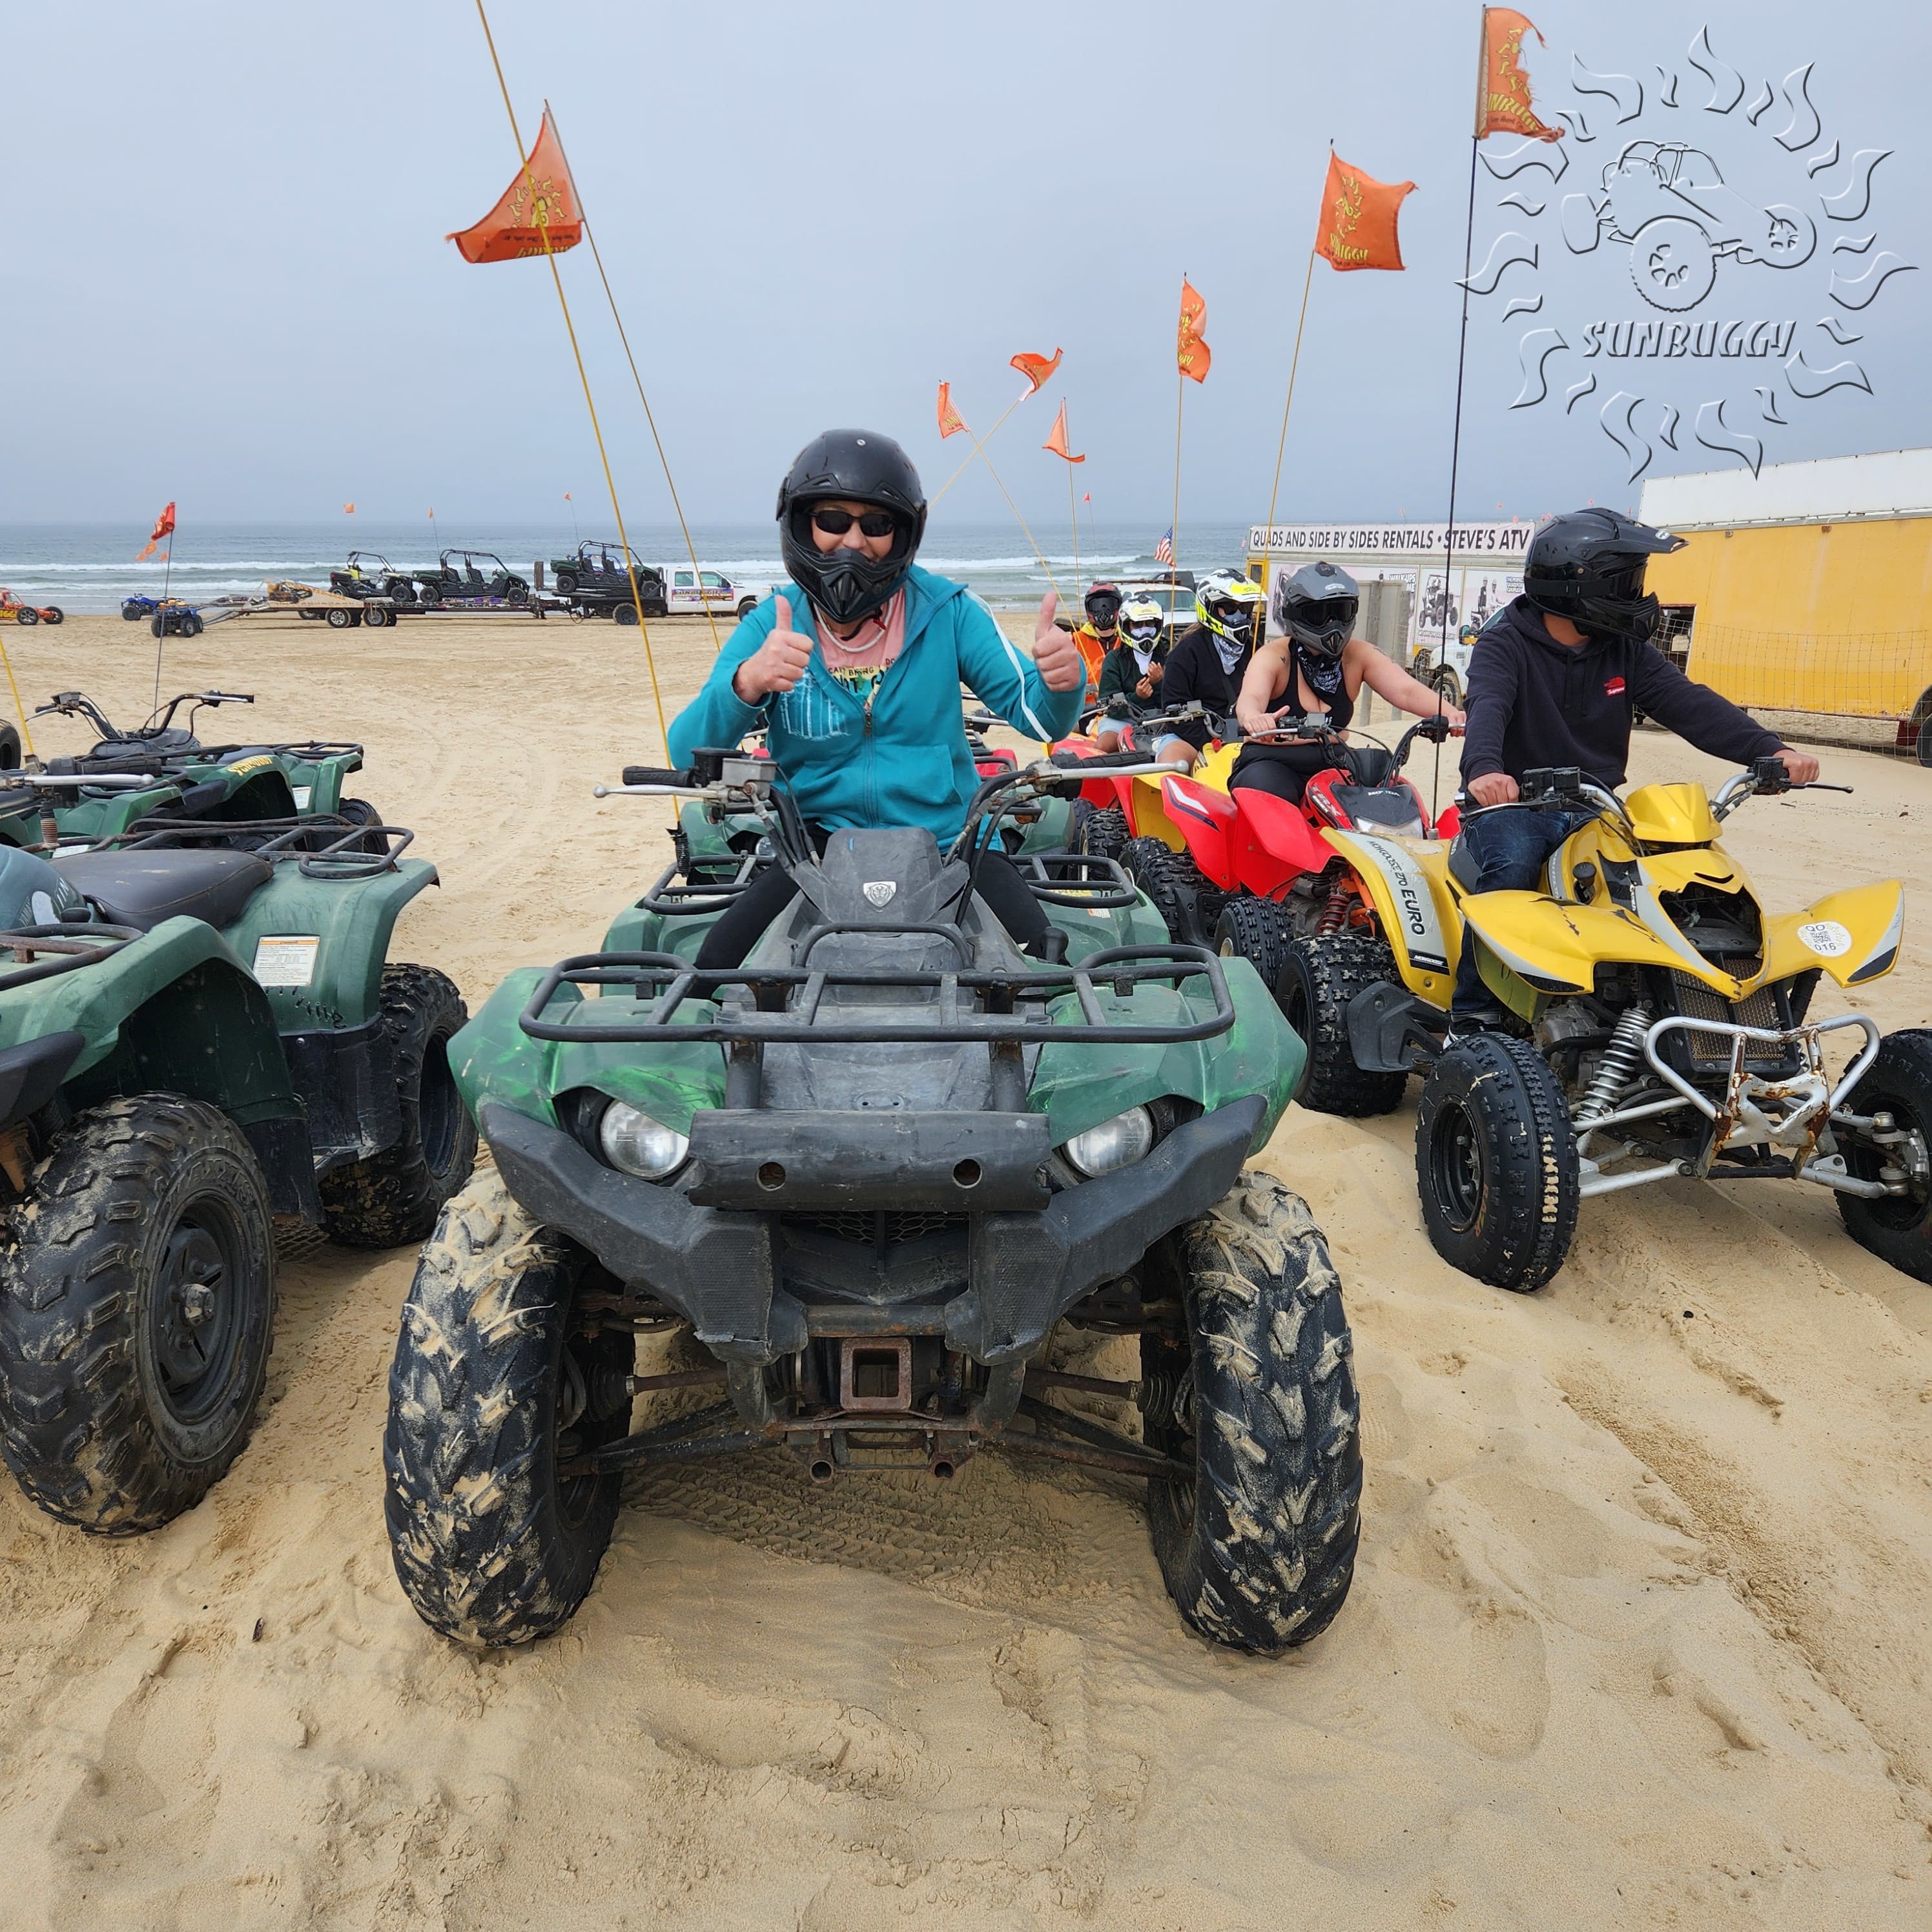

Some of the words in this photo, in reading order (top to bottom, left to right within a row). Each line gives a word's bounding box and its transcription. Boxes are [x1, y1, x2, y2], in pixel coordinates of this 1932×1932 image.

[1253, 531, 1283, 547] QUADS
[1285, 531, 1306, 548] AND
[1308, 531, 1331, 548] SIDE
[1333, 531, 1348, 548] BY
[1349, 530, 1379, 549] SIDES
[1382, 530, 1434, 549] RENTALS
[1443, 529, 1495, 550] STEVE'S
[1499, 529, 1530, 550] ATV
[1395, 872, 1408, 887] 270
[1401, 889, 1426, 936] EURO
[1814, 943, 1837, 951] 016
